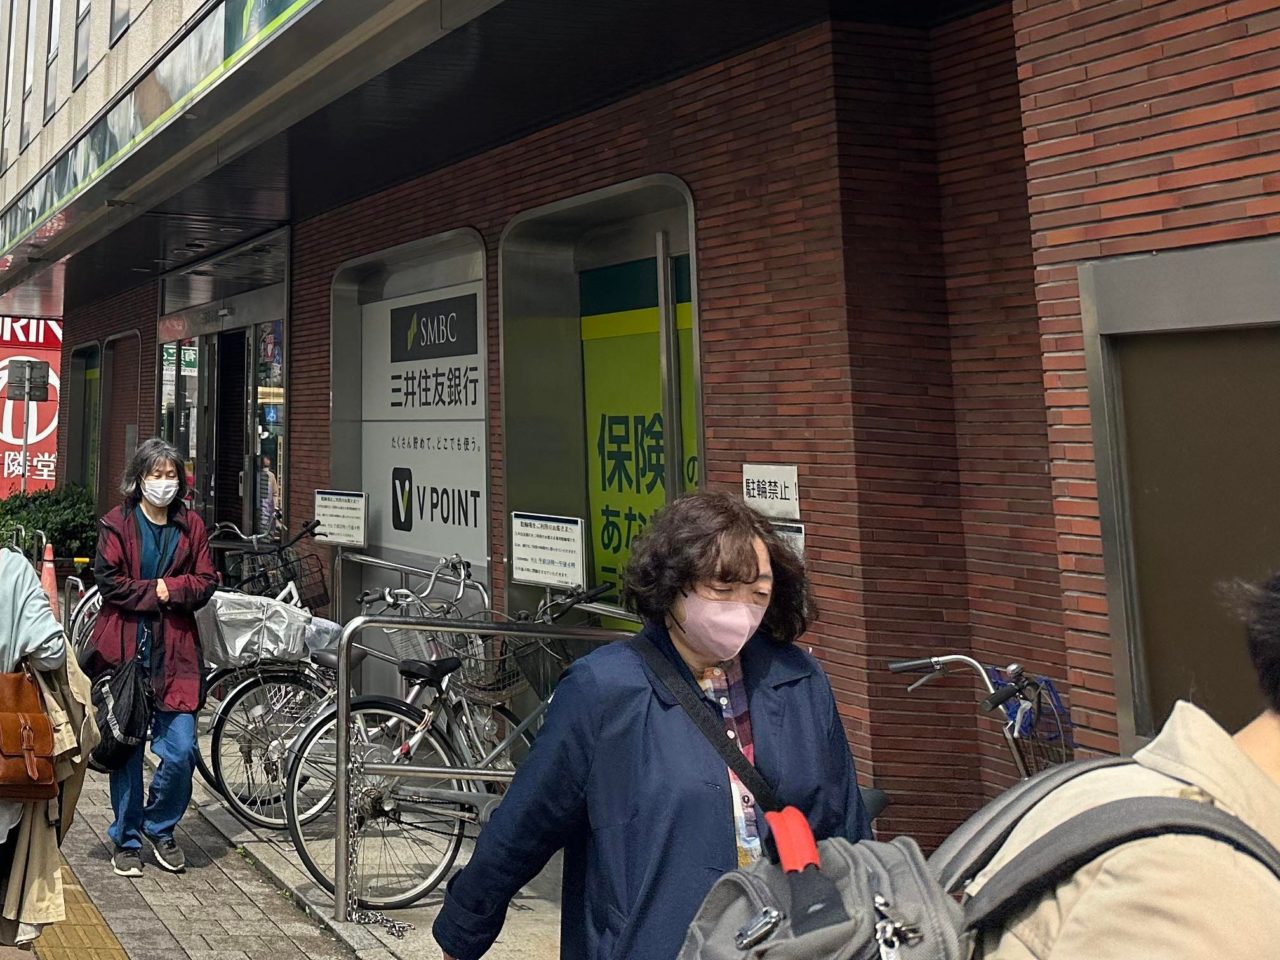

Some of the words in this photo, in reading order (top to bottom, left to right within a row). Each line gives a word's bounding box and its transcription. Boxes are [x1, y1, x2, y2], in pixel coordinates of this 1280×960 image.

[420, 312, 457, 347] SMBC
[390, 365, 479, 408] 三井住友銀行
[391, 435, 481, 453] たくさん貯めて、どこでも使う。
[416, 485, 426, 520] V
[430, 486, 480, 528] POINT
